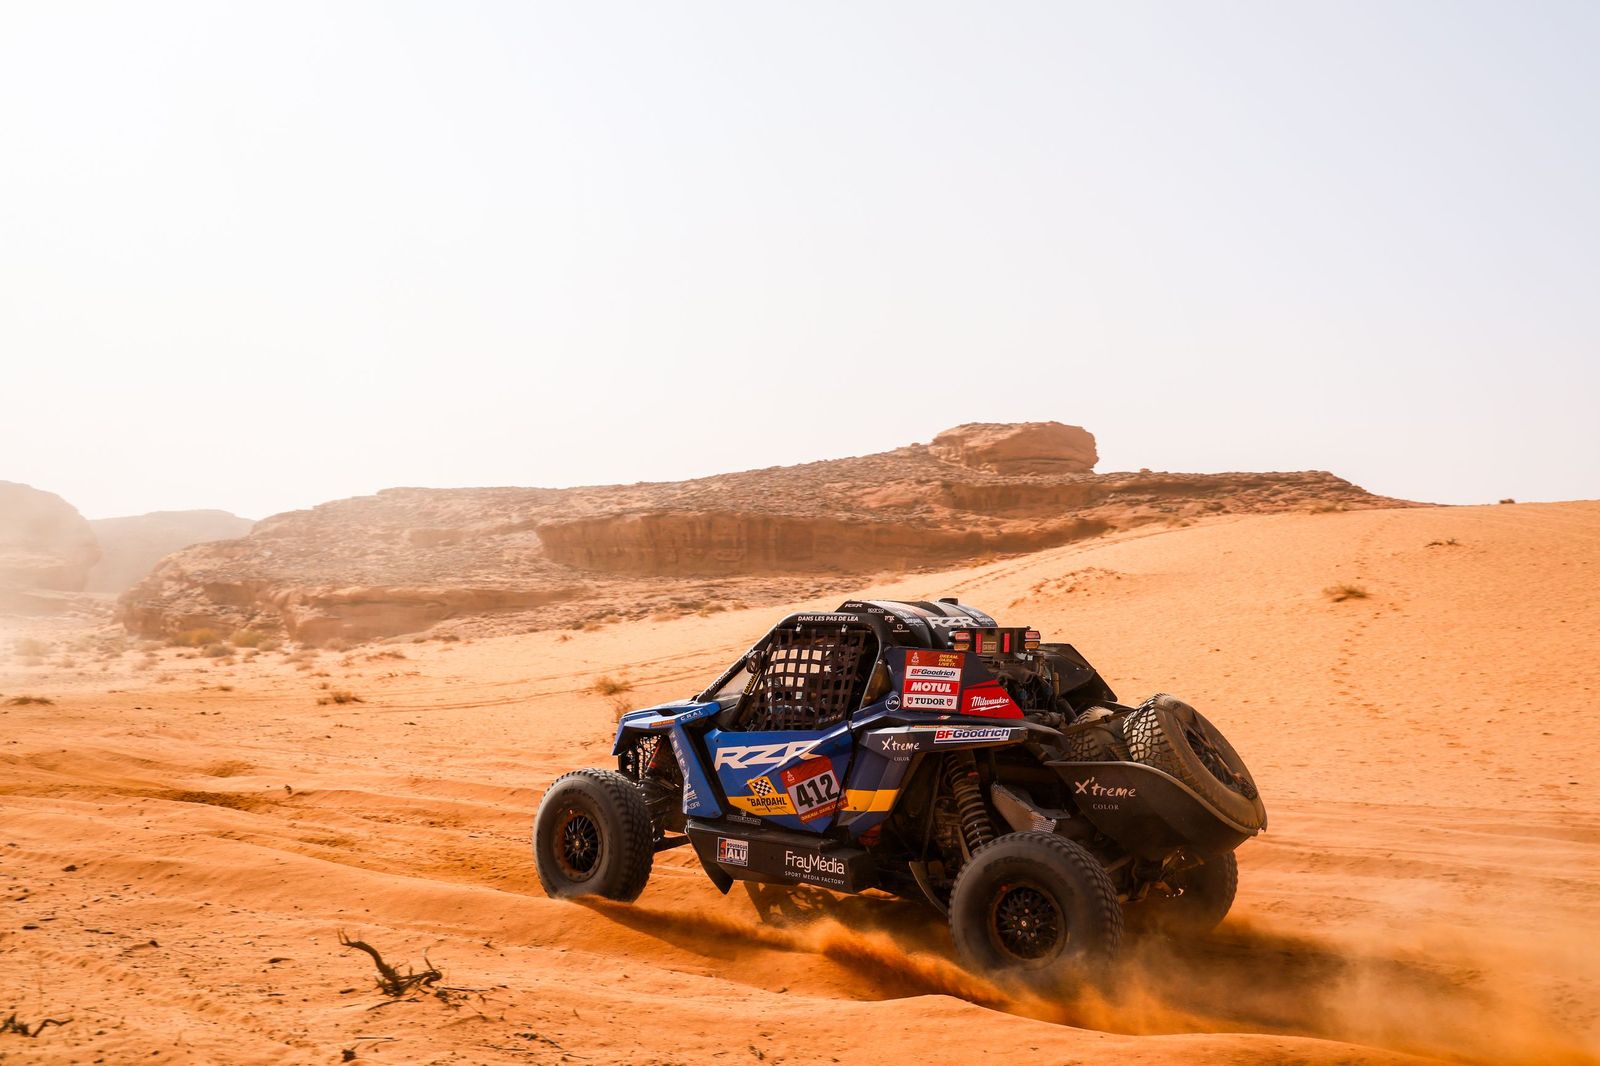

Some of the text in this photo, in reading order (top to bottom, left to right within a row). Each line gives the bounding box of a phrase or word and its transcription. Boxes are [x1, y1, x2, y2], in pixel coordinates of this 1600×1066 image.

[926, 616, 981, 630] RZR
[911, 668, 956, 676] BFGoodrich
[910, 682, 952, 692] MOTUL
[914, 697, 945, 706] TUDOR
[970, 696, 1010, 707] Milwaukee
[936, 728, 1010, 739] BFGoodrich
[882, 736, 920, 751] X'treme
[714, 740, 822, 771] RZR
[796, 774, 838, 808] 412
[1074, 776, 1136, 798] X'treme
[750, 797, 788, 807] BARDAHL
[728, 848, 746, 861] ALU
[785, 850, 845, 874] FrayMédia
[802, 873, 820, 881] MEDIA
[821, 876, 844, 884] FACTORY
